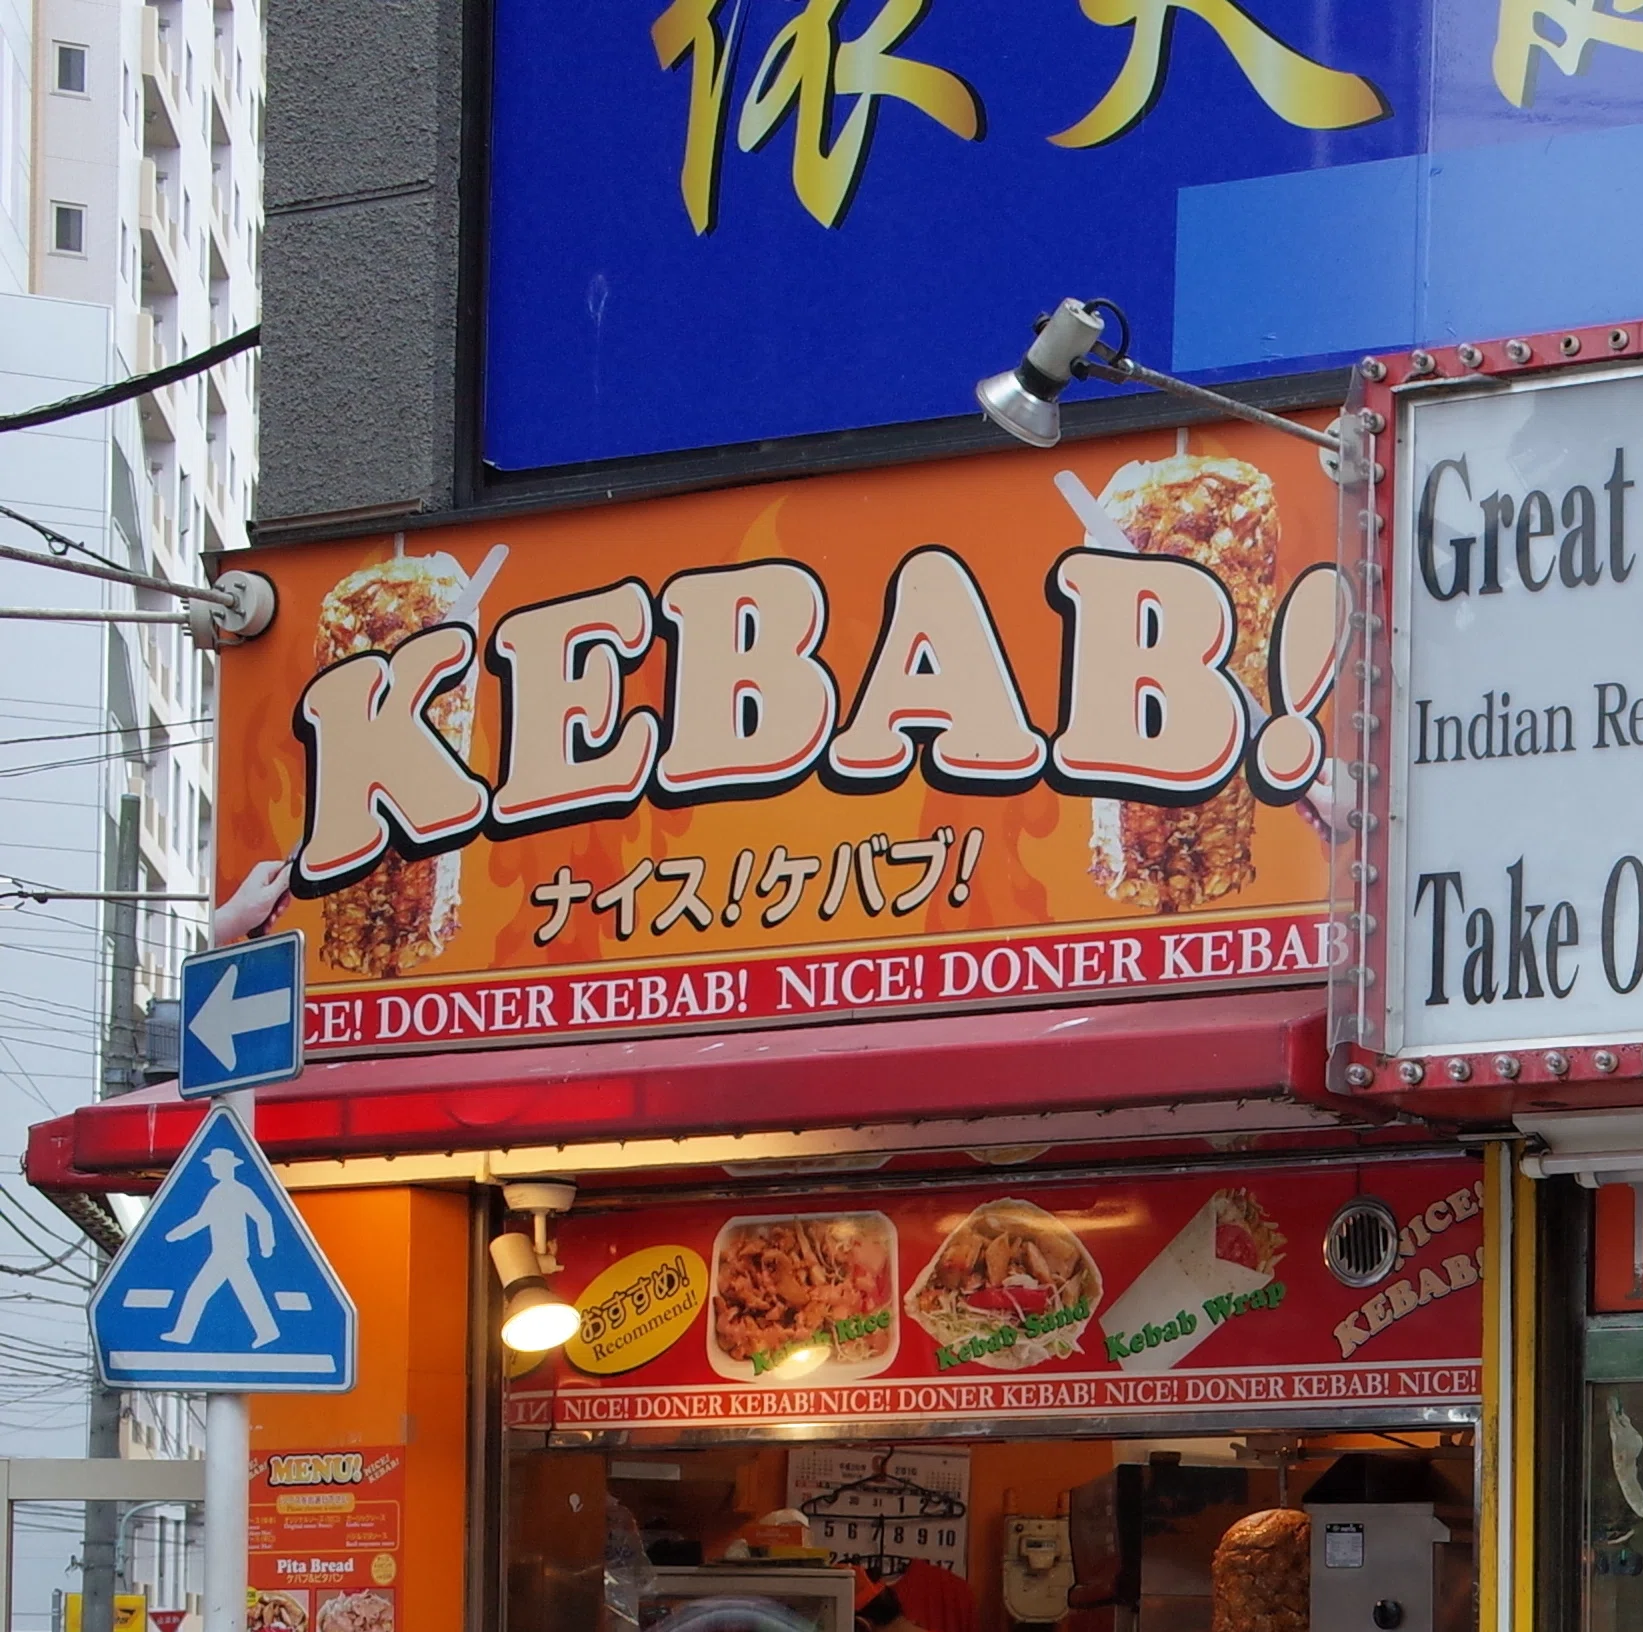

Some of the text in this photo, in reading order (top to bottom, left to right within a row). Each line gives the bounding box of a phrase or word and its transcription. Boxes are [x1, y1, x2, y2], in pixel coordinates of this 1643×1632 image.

[1417, 445, 1636, 602] Great
[293, 545, 1359, 900] KEBAB!
[1412, 686, 1578, 766] Indian
[1414, 855, 1581, 1007] Take
[305, 1000, 363, 1045] CE!
[375, 985, 558, 1038] DONER
[569, 970, 748, 1024] KEBAB!
[776, 956, 923, 1010] NICE!
[939, 936, 1144, 995] DONER
[579, 1256, 691, 1344] おすすめ!
[592, 1289, 698, 1361] Recommend!
[837, 1311, 891, 1345] Rice
[935, 1296, 1091, 1370] Kebab Sand
[1106, 1281, 1287, 1363] Kebab Wrap
[1331, 1247, 1485, 1358] KEBAB!
[563, 1369, 1477, 1421] NICE! DONER KEBAB! NICE! DONER KEBAB! NICE! DONER KEBAB! NICE!
[268, 1453, 364, 1487] MENU!
[277, 1558, 353, 1573] Pita Bread
